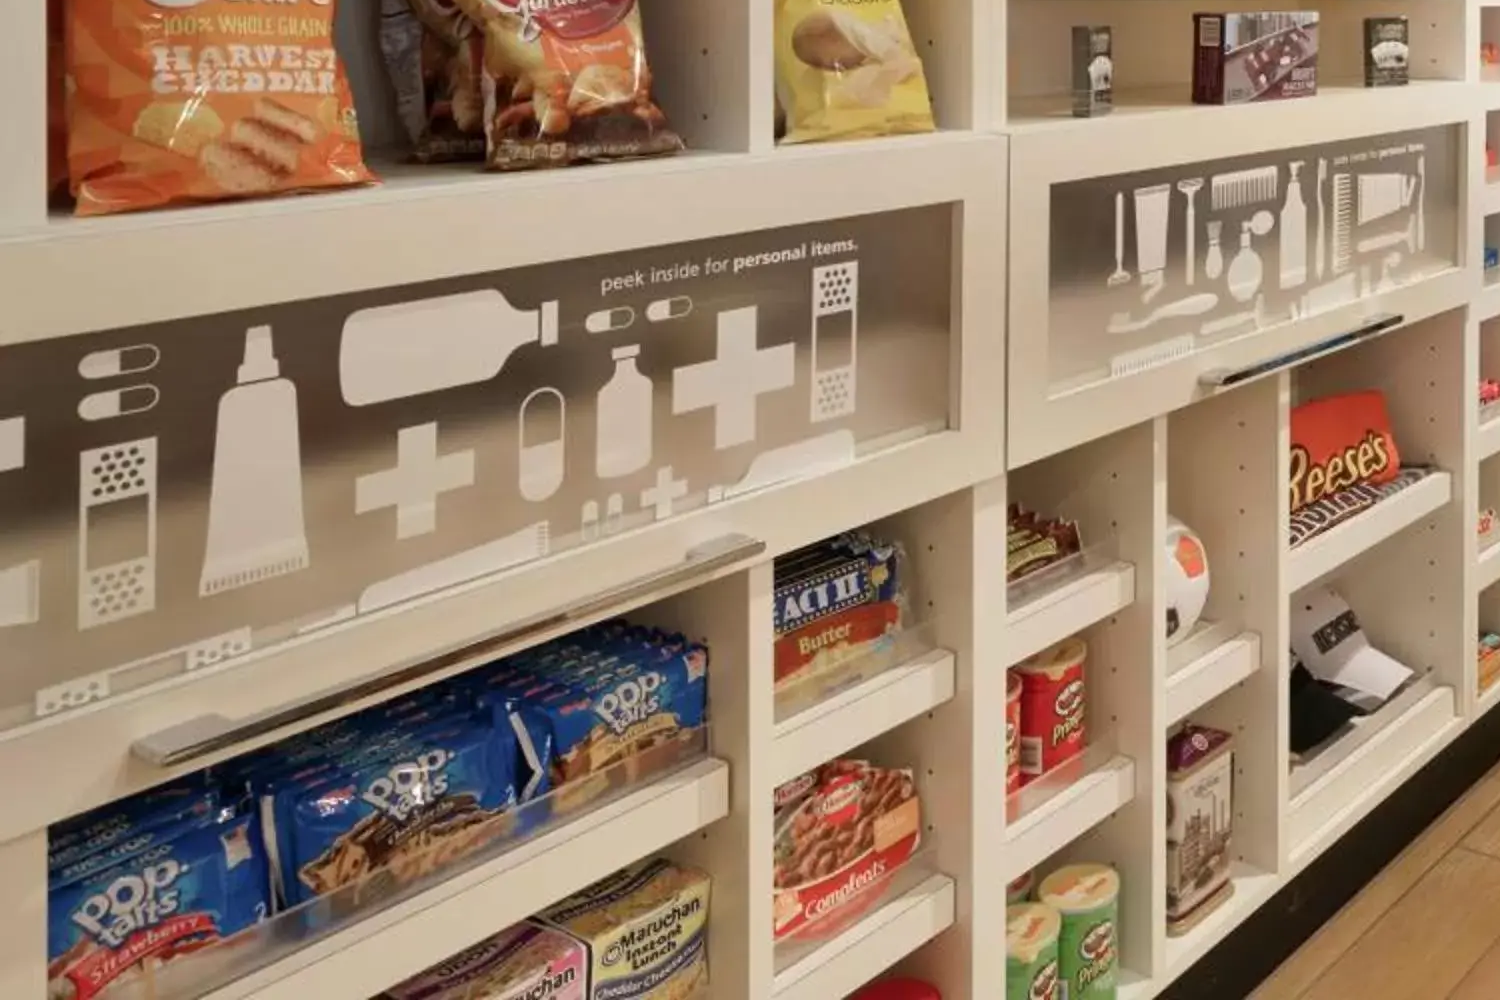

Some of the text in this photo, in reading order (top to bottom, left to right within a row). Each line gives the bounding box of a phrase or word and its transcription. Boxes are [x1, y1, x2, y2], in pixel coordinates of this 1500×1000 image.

[162, 14, 329, 37] 100% WHOLE GRAIN
[153, 43, 338, 71] HARVEST
[601, 238, 859, 297] peek inside for personal items.
[1289, 430, 1390, 512] Reese's
[783, 583, 830, 623] ACT
[797, 621, 851, 656] Butter
[619, 896, 701, 948] Maruchan
[89, 916, 201, 985] Strawberry
[632, 940, 678, 971] Lunch
